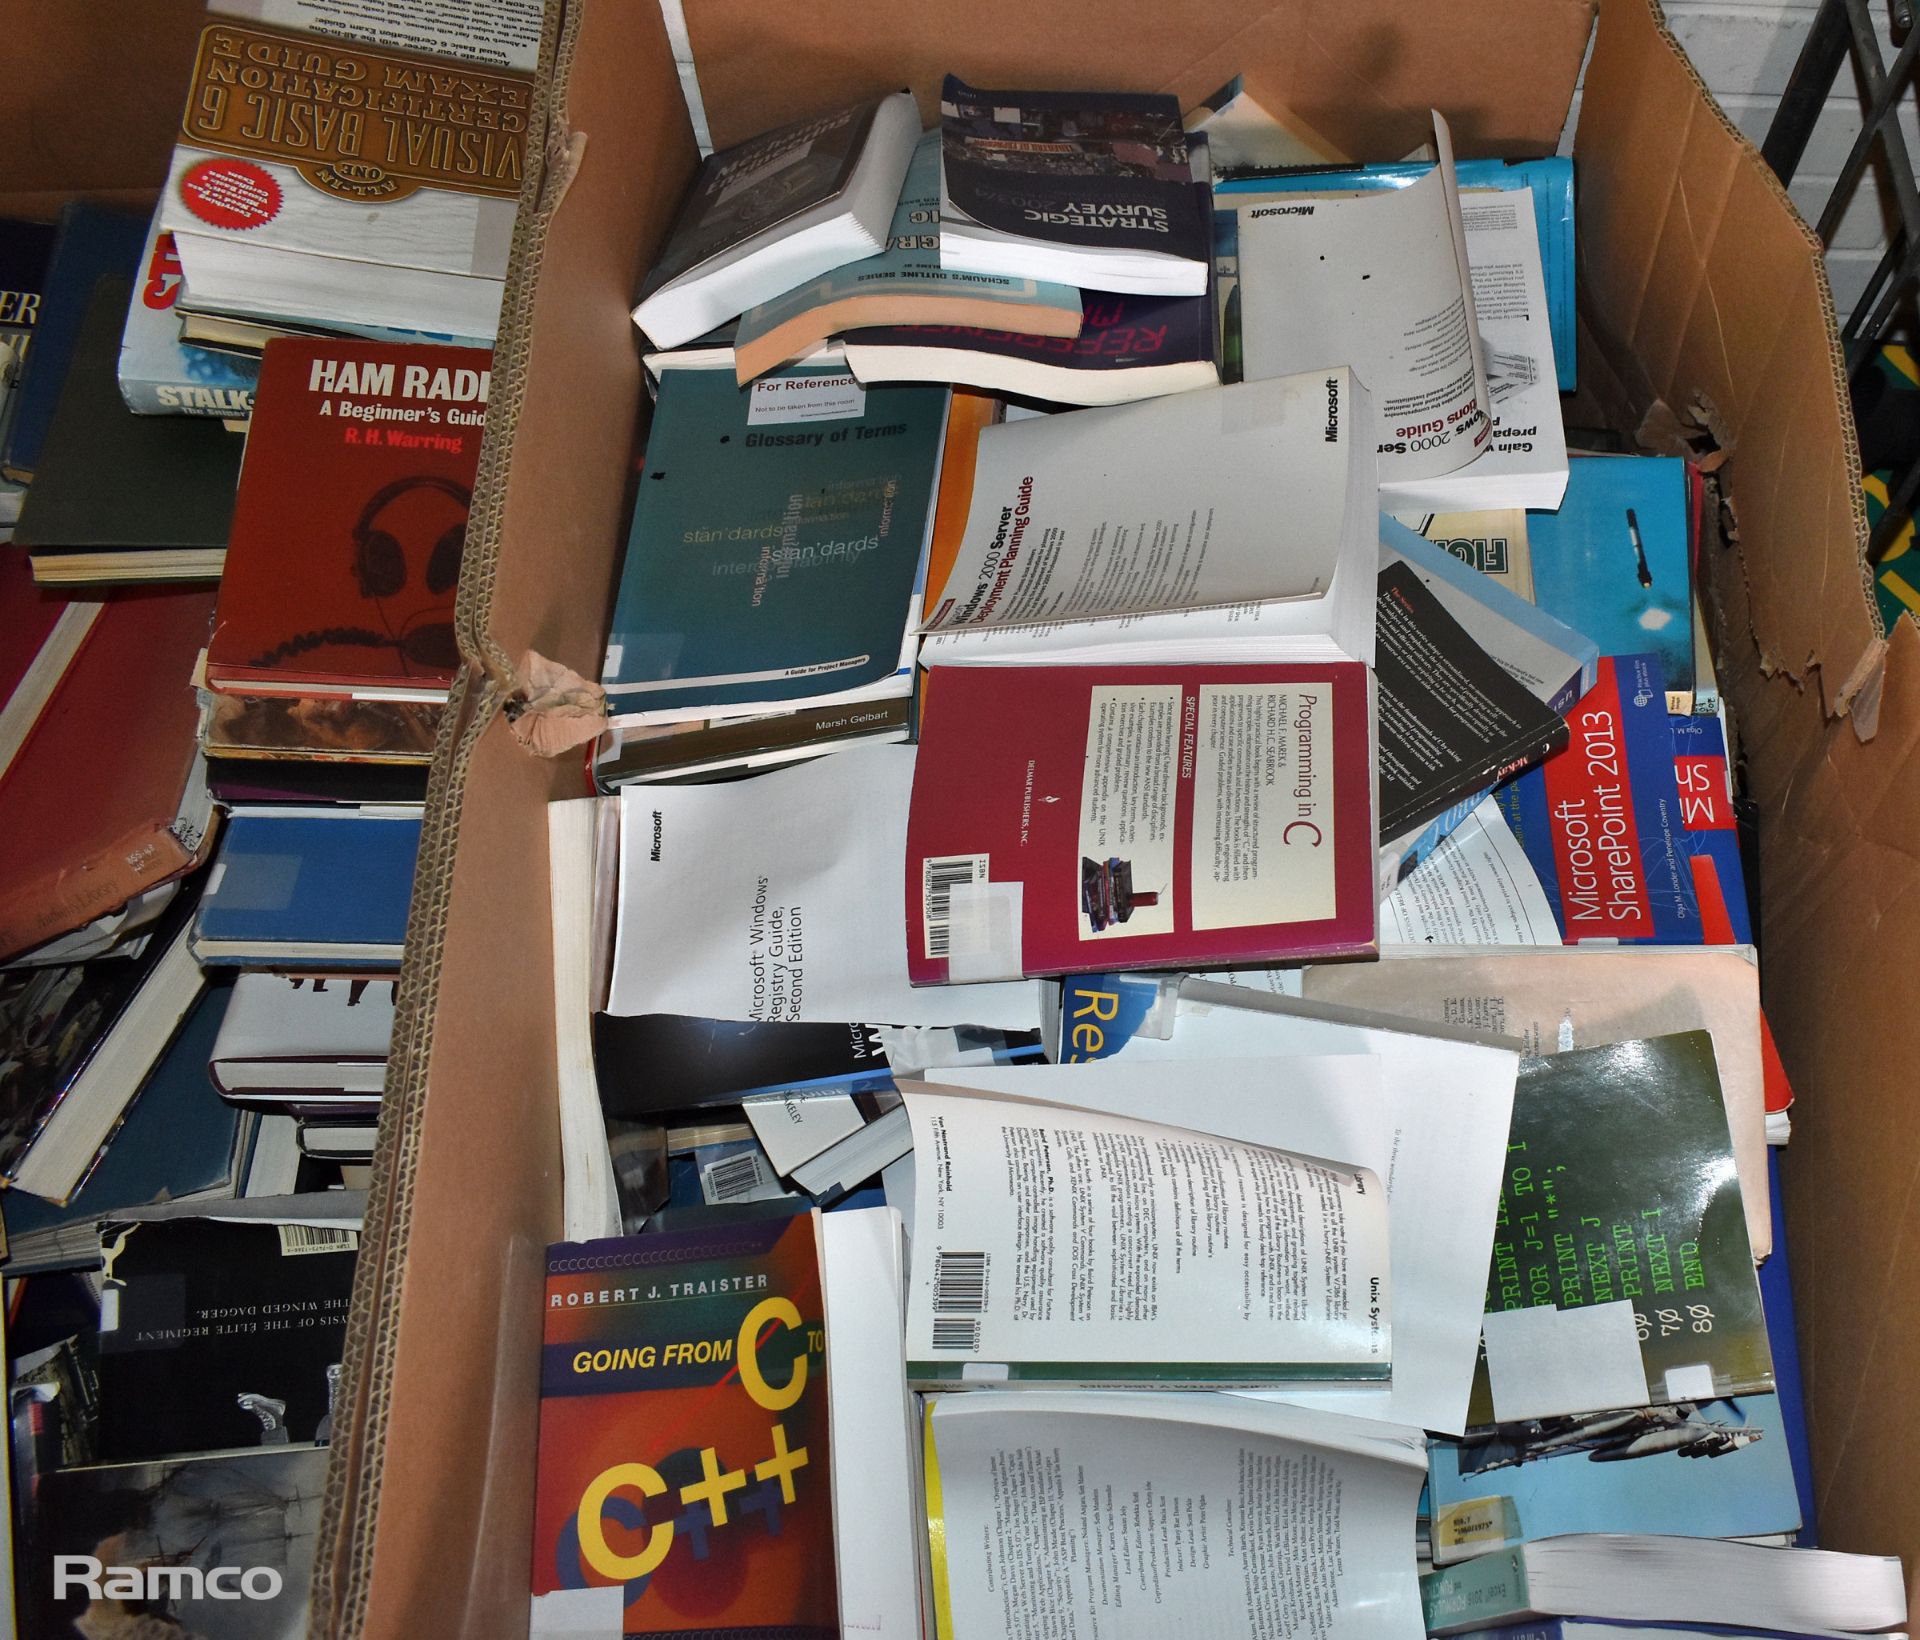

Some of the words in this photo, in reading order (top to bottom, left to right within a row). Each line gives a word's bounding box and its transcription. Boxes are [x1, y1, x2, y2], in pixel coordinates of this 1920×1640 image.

[349, 24, 376, 34] Exam
[379, 29, 438, 46] Certification
[212, 32, 367, 81] GUIDE
[450, 43, 476, 53] Basic
[478, 46, 506, 58] Visual
[207, 58, 527, 133] CERTIFICATION
[383, 66, 529, 110] EXAM
[198, 84, 228, 131] 6
[241, 92, 364, 157] BASIC
[384, 117, 521, 181] VISUAL
[341, 163, 383, 179] ONE
[1024, 209, 1169, 234] STRATEGIC
[1062, 202, 1167, 219] SURVEY
[1250, 204, 1315, 218] Microsoft
[857, 272, 896, 281] SERIES
[901, 271, 946, 280] OUTLINE
[952, 273, 1010, 285] SCHAUM'S
[308, 359, 396, 397] HAM
[402, 364, 492, 403] RADI
[757, 383, 781, 392] For
[785, 378, 856, 390] Reference
[319, 400, 332, 416] A
[339, 401, 440, 424] Beginner's
[447, 408, 486, 427] Guid
[1324, 379, 1339, 443] Microsoft
[344, 427, 362, 445] R.
[365, 429, 383, 446] H.
[387, 430, 463, 455] Warring
[745, 431, 824, 449] Glossary
[830, 427, 848, 442] of
[854, 421, 908, 441] Terms
[1396, 418, 1444, 440] Guide
[1410, 430, 1451, 453] 2000
[1493, 426, 1537, 439] prepa
[1498, 442, 1533, 453] Gain
[970, 570, 1011, 624] Deployment
[999, 517, 1030, 568] Planning
[1015, 476, 1033, 516] Guide
[978, 552, 1001, 580] 2000
[990, 507, 1012, 550] Server
[790, 667, 807, 675] Guide
[817, 663, 839, 672] Project
[839, 656, 867, 668] Managers
[815, 718, 848, 730] Marsh
[850, 710, 889, 724] Gelbart
[1184, 696, 1196, 732] SPECIAL
[1267, 695, 1276, 727] RICHARD
[1279, 694, 1287, 727] MICHAEL
[1267, 729, 1275, 745] H.C.
[1686, 725, 1703, 735] Olga
[1103, 733, 1113, 773] comprehensive
[1182, 733, 1194, 778] FEATURES
[1278, 736, 1286, 761] MAREK
[1293, 694, 1318, 797] Programming
[1582, 711, 1619, 776] 2013
[1026, 760, 1035, 785] DELMAR
[1266, 746, 1274, 786] SEABROOK
[1496, 754, 1529, 782] McKay
[1101, 775, 1110, 801] appendix
[1021, 787, 1032, 829] PUBLISHERS,
[1101, 804, 1106, 812] on
[1142, 792, 1150, 821] standards.
[1159, 793, 1169, 831] backgrounds,
[1298, 803, 1316, 817] in
[1658, 798, 1670, 828] Coventry
[1100, 815, 1108, 825] the
[650, 811, 662, 861] Microsoft
[1020, 830, 1028, 847] INC.
[1098, 828, 1106, 847] UNIX
[1283, 821, 1322, 847] C
[1663, 829, 1676, 858] Penelope
[1214, 840, 1222, 870] difficulty,
[1250, 850, 1258, 880] program-
[1554, 799, 1603, 920] Microsoft
[1593, 784, 1641, 920] SharePoint
[1669, 858, 1677, 871] and
[1671, 872, 1680, 893] Londer
[1676, 901, 1686, 919] Olga
[768, 906, 784, 957] Guide,
[788, 907, 802, 962] Edition
[768, 963, 788, 1023] Registry
[786, 969, 803, 1021] Second
[937, 1116, 945, 1127] Van
[940, 1130, 950, 1159] Nostrand
[1039, 1128, 1049, 1144] Baird
[1507, 1141, 1527, 1153] I
[934, 1139, 942, 1161] Avenue,
[1042, 1145, 1052, 1175] Peterson,
[936, 1177, 944, 1193] York,
[944, 1161, 952, 1191] Reinhold
[1047, 1176, 1055, 1194] Ph.D.
[1353, 1173, 1366, 1195] Library
[1512, 1167, 1534, 1196] TO
[938, 1196, 944, 1207] NY
[1641, 1207, 1661, 1220] I
[1047, 1209, 1055, 1234] software
[1241, 1211, 1250, 1239] designed
[1581, 1216, 1601, 1228] J
[1047, 1236, 1055, 1255] quality
[1242, 1253, 1250, 1267] easy
[1554, 1234, 1583, 1307] PRINT
[1613, 1224, 1643, 1299] PRINT
[1645, 1234, 1674, 1295] NEXT
[1680, 1242, 1705, 1290] END
[1585, 1243, 1614, 1305] NEXT
[551, 1287, 639, 1306] ROBERT
[648, 1284, 661, 1299] J.
[670, 1274, 767, 1297] TRAISTER
[1243, 1270, 1251, 1310] accessibility
[1370, 1276, 1380, 1303] Unix
[196, 1306, 256, 1319] DAGGER.
[262, 1301, 318, 1313] WINGED
[323, 1298, 350, 1309] THE
[1046, 1298, 1054, 1321] Fortune
[135, 1326, 209, 1341] REGIMENT
[216, 1322, 257, 1335] ÉLITE
[263, 1319, 291, 1331] THE
[297, 1317, 315, 1328] OF
[572, 1345, 656, 1373] GOING
[662, 1339, 732, 1367] FROM
[737, 1296, 808, 1410] C
[807, 1330, 825, 1353] TO
[578, 1424, 808, 1580] C++
